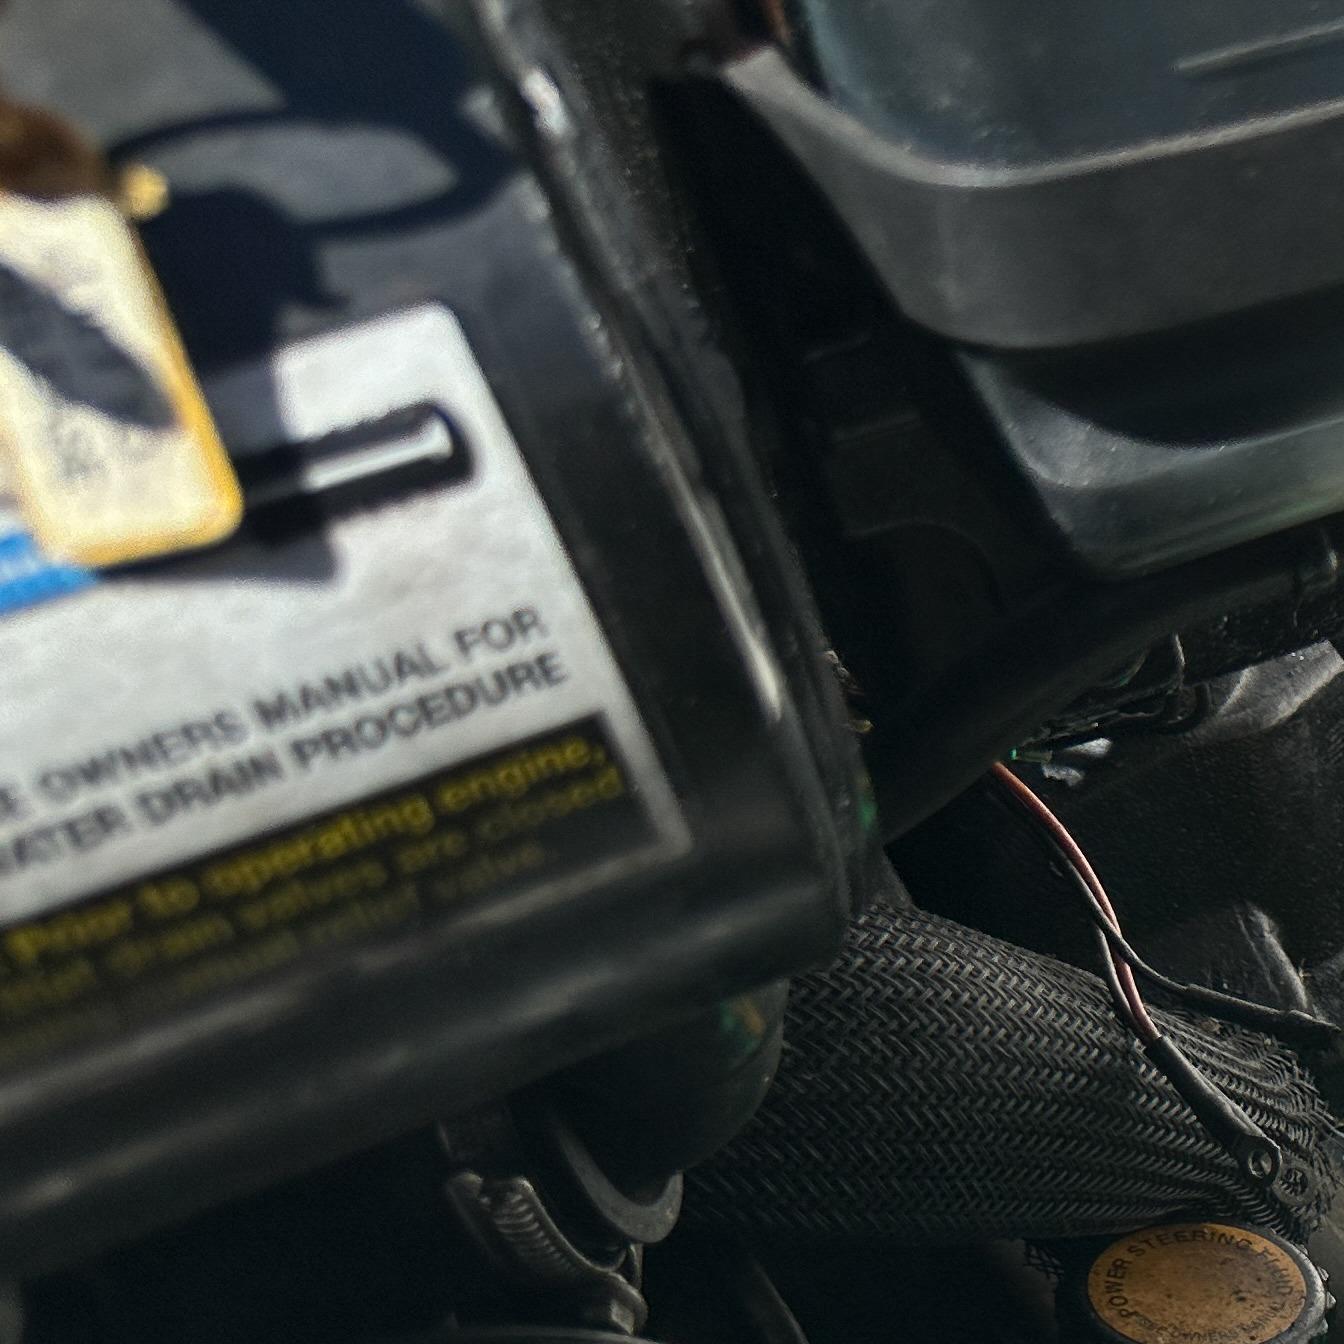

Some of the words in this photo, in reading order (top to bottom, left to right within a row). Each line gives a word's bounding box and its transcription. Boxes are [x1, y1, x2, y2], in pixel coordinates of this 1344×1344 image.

[249, 643, 453, 736] MANUAL
[453, 605, 551, 663] FOR
[0, 803, 133, 880] ATER
[134, 749, 283, 826] DRAIN
[288, 650, 568, 773] PROCEDURE
[137, 879, 199, 918] to
[205, 796, 435, 896] operating
[1105, 1258, 1132, 1318] POWER
[1129, 1230, 1252, 1257] STEERING
[1256, 1246, 1293, 1296] FLUID
